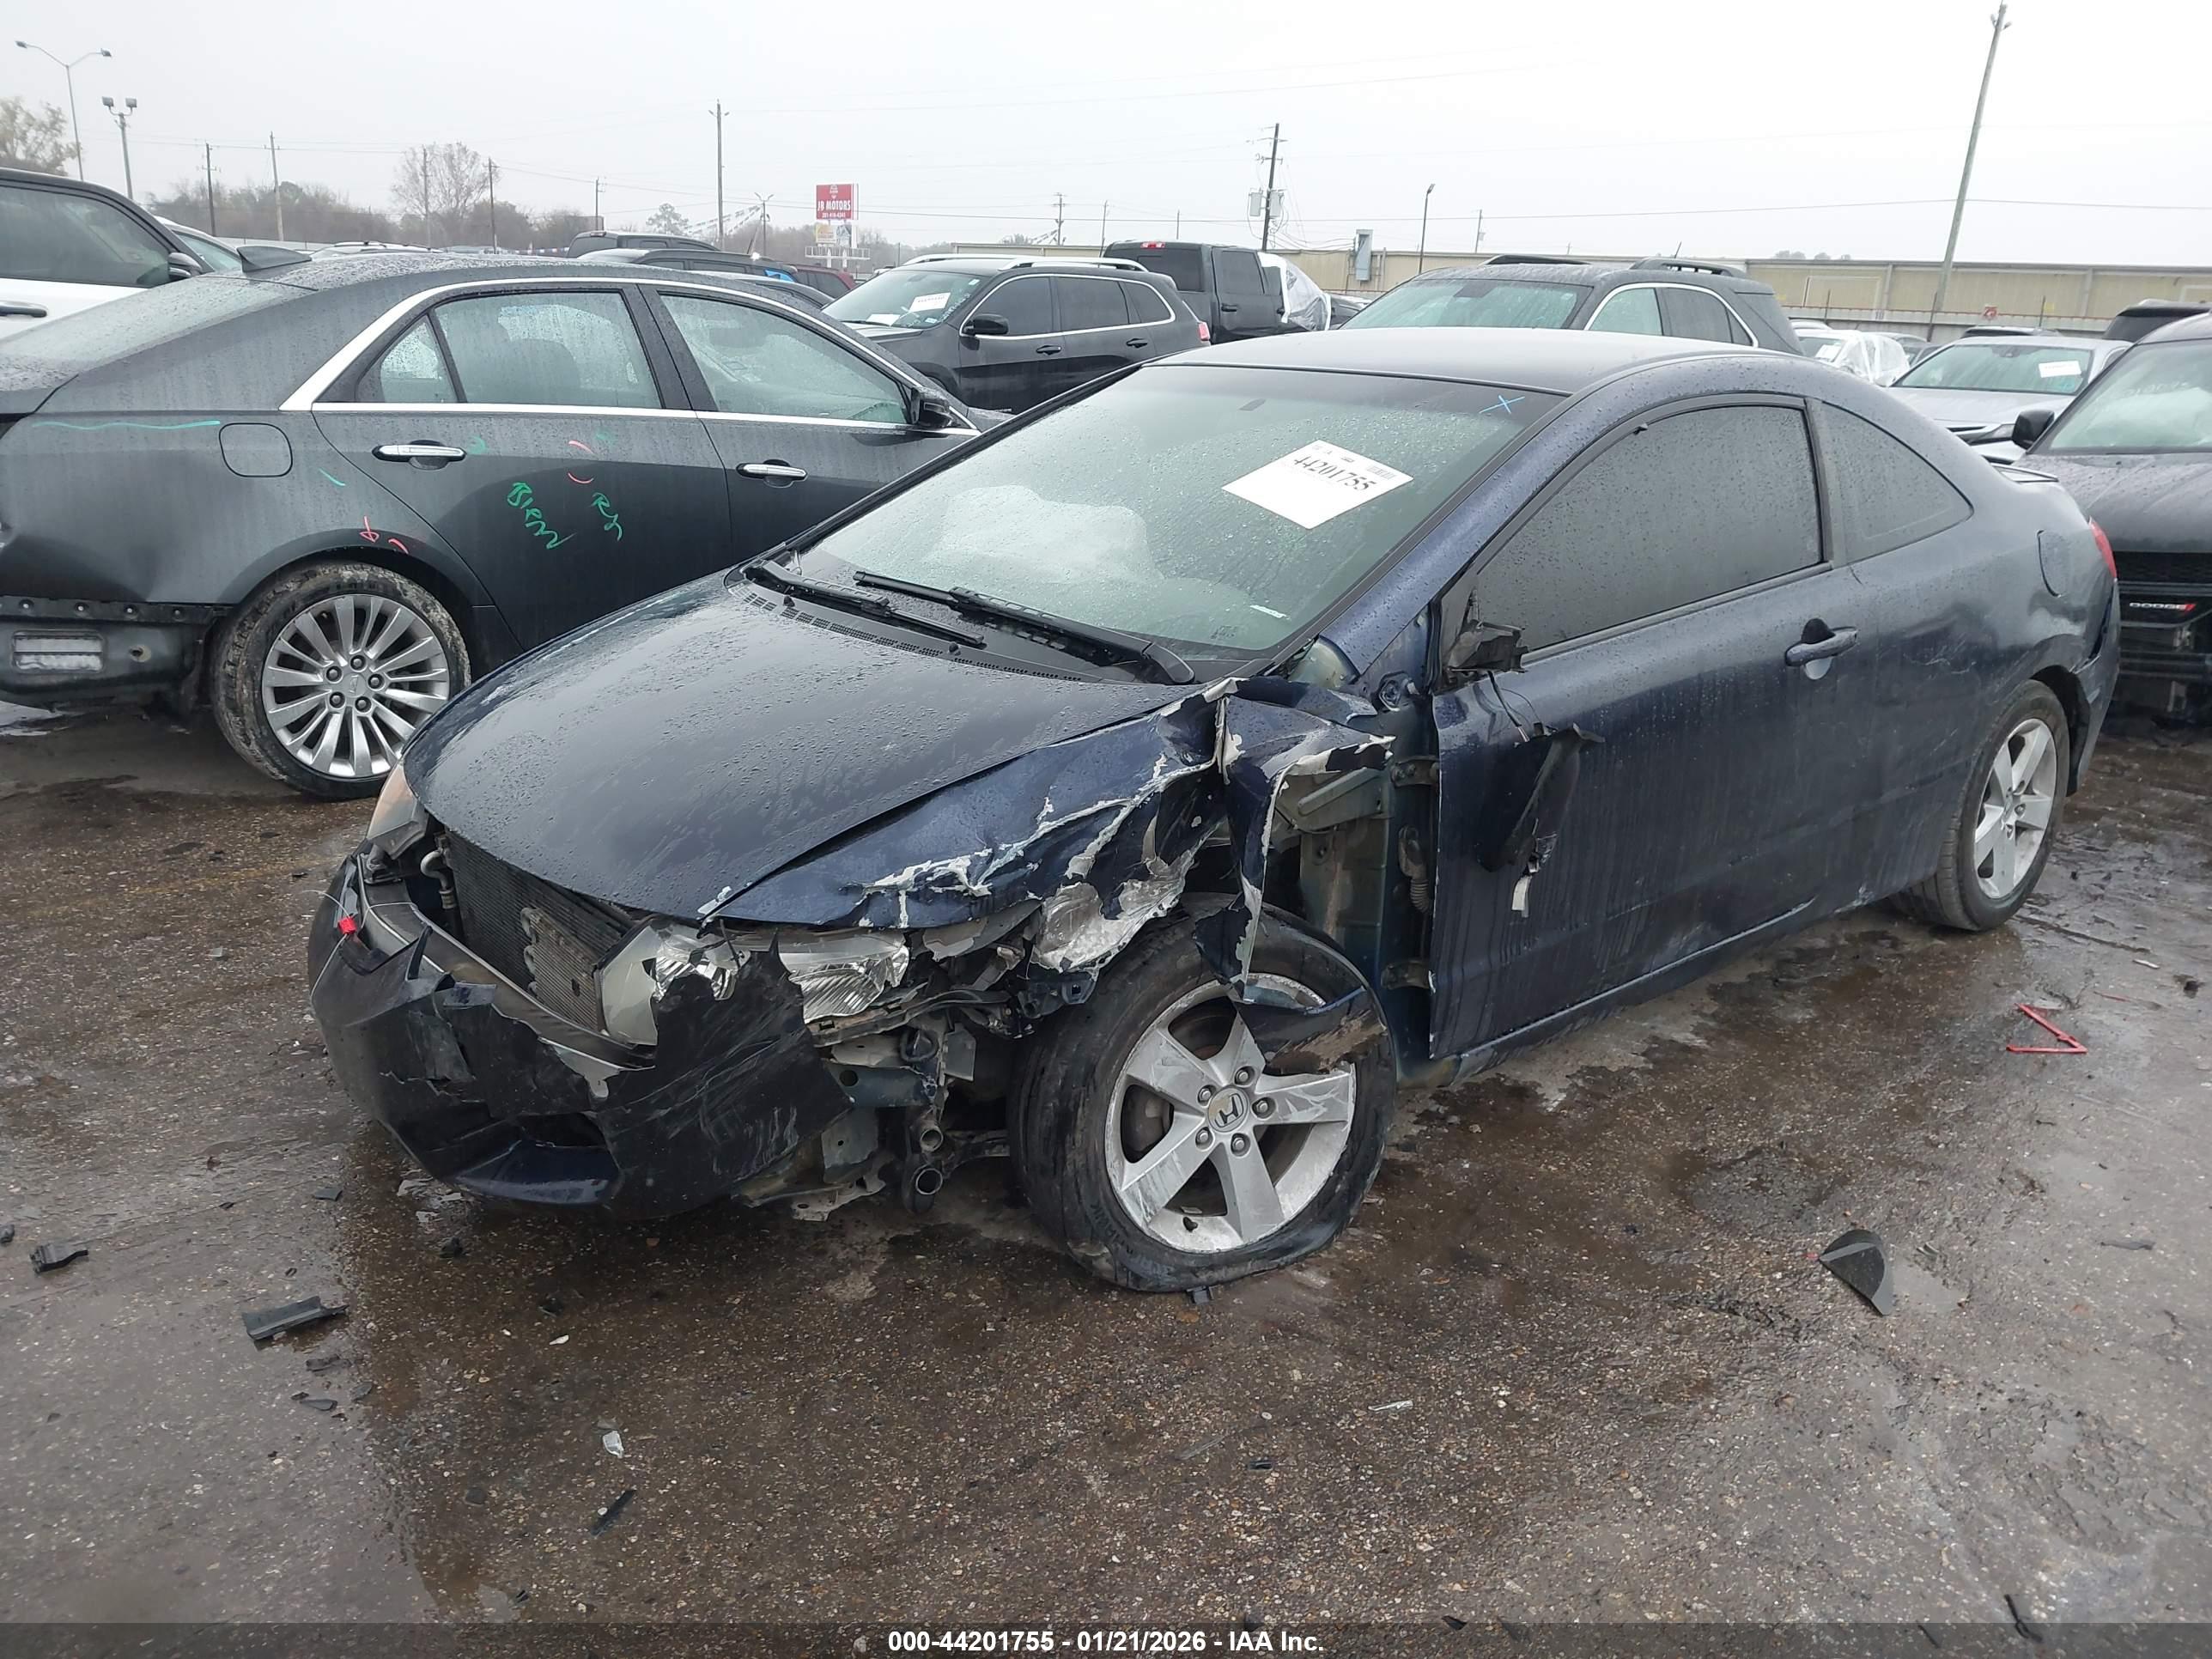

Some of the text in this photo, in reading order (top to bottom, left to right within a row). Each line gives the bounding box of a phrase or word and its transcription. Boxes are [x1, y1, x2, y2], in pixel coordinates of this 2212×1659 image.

[817, 199, 851, 211] JB MOTORS
[1294, 455, 1376, 490] 44201755
[2130, 602, 2187, 611] DODGE
